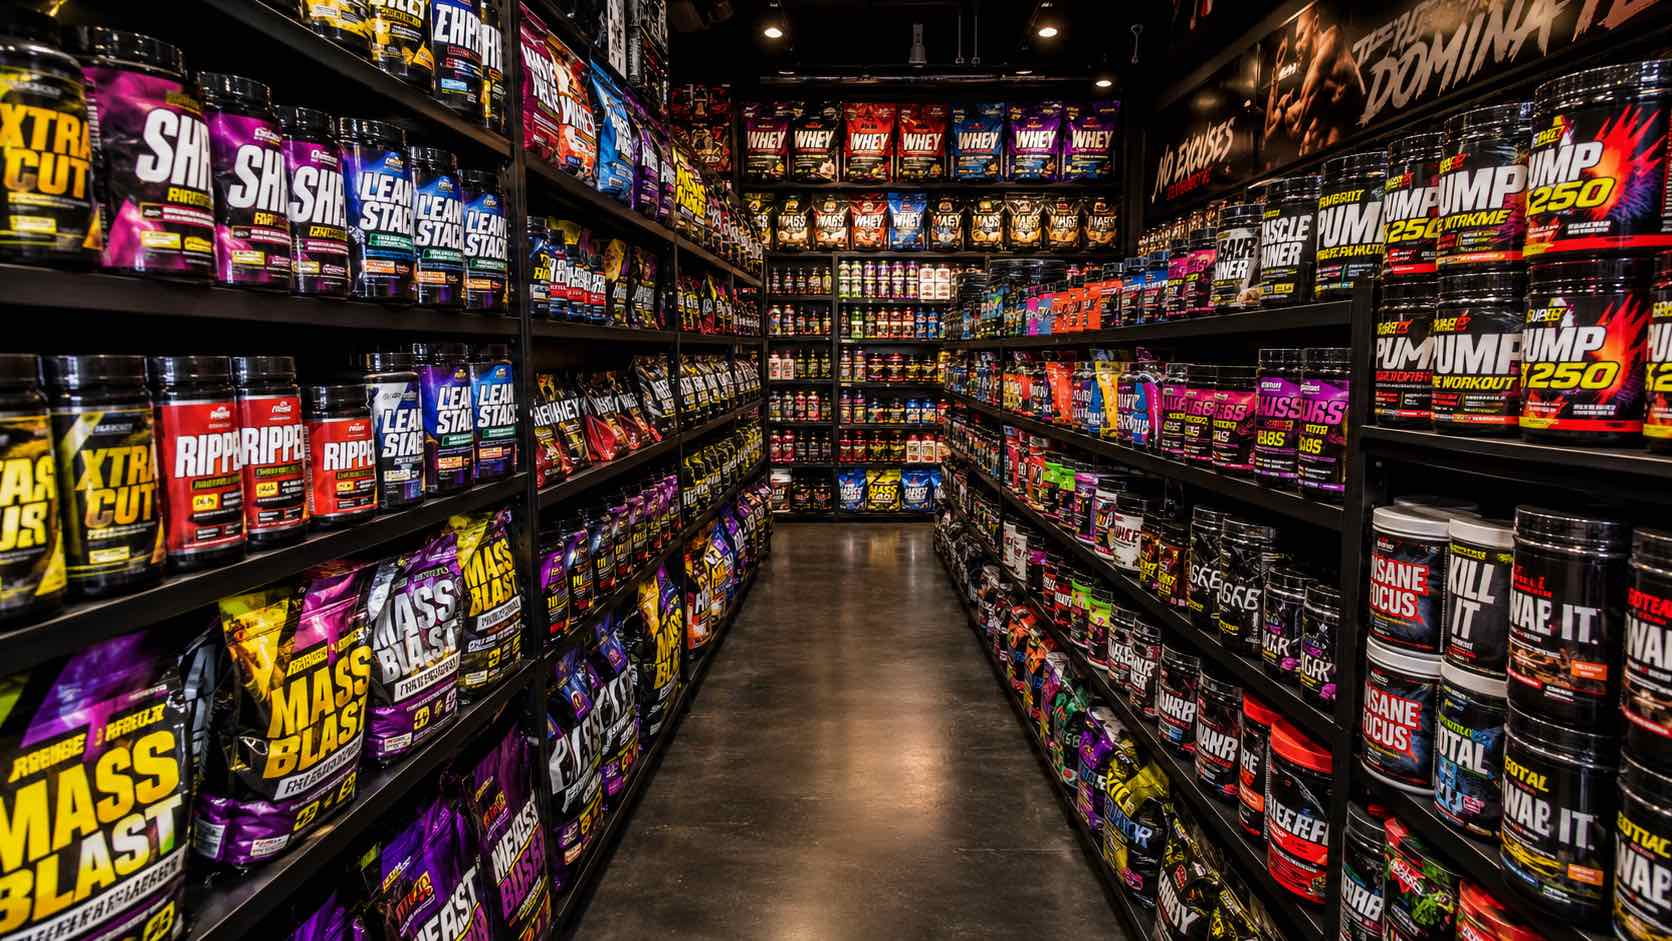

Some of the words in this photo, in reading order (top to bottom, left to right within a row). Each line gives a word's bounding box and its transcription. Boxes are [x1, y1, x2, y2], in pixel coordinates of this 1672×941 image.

[748, 131, 787, 149] WHEY
[794, 131, 834, 149] WHEY
[851, 133, 889, 150] WHEY
[904, 133, 942, 150] WHEY
[958, 131, 998, 149] WHEY
[1016, 131, 1056, 149] WHEY
[1072, 131, 1114, 149] WHEY
[1152, 144, 1174, 204] NO
[1174, 116, 1236, 183] EXCUSES
[4, 148, 91, 199] CUT
[1528, 141, 1604, 191] UMP
[854, 215, 883, 228] WHEY
[1317, 202, 1385, 250] PUM
[1376, 337, 1436, 370] PUM
[1442, 376, 1517, 390] WORKOUT
[85, 486, 156, 529] CUT
[463, 539, 513, 590] MASS
[1448, 554, 1496, 604] KILL
[468, 568, 518, 617] BLAST
[1450, 597, 1480, 640] IT
[376, 618, 458, 685] BLAST
[267, 645, 371, 738] MASS
[262, 692, 367, 779] BLAST
[0, 730, 180, 874] MASS
[0, 793, 183, 938] BLAST
